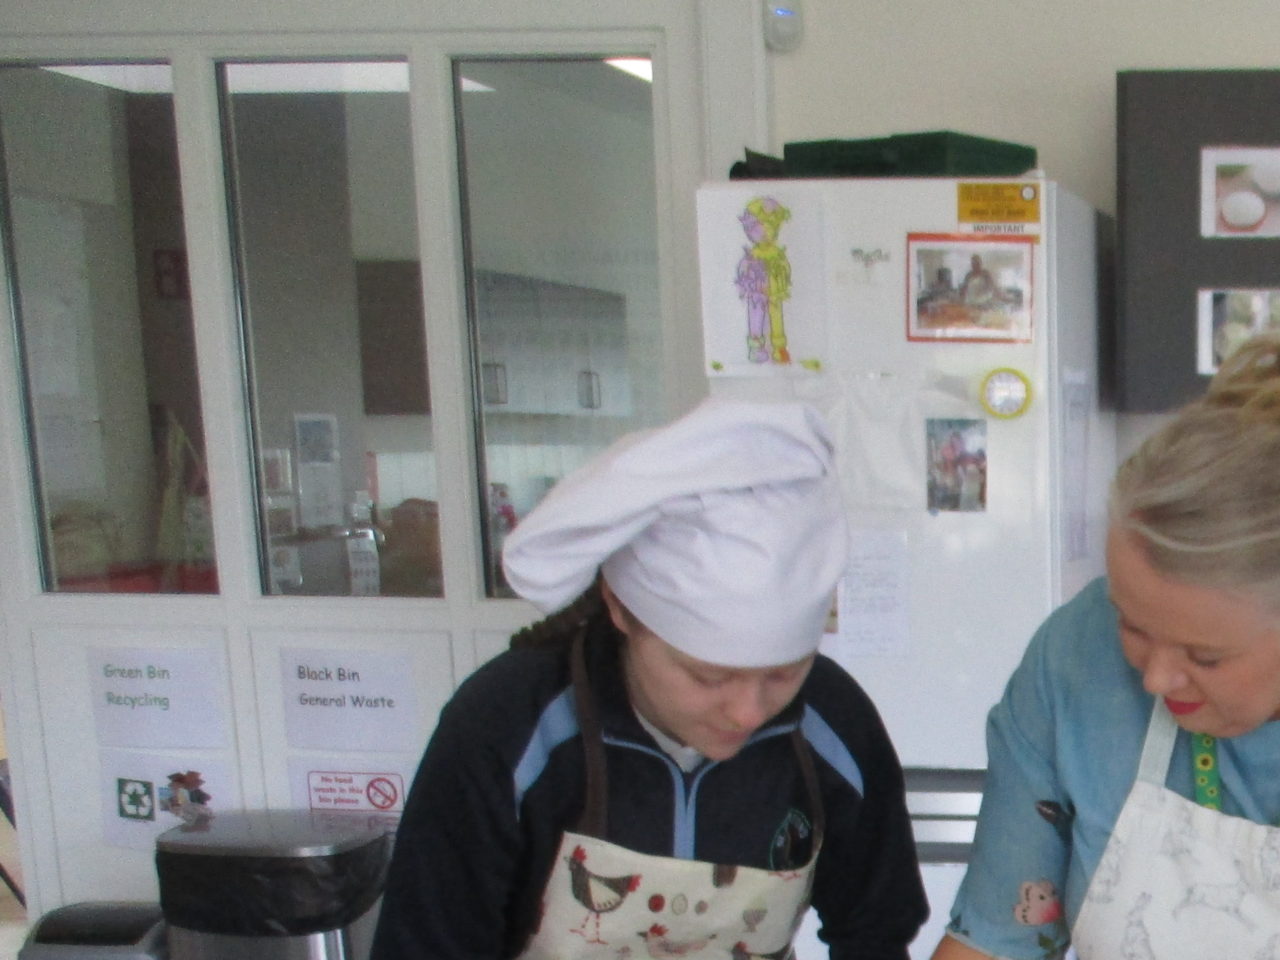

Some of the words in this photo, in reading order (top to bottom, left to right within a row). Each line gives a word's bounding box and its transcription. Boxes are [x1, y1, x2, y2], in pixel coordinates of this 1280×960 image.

[103, 663, 143, 679] Green
[147, 664, 171, 680] Bin
[297, 665, 333, 681] Black
[337, 667, 361, 682] Bin
[105, 691, 170, 711] Recycling
[299, 692, 346, 707] General
[350, 695, 396, 709] Waste
